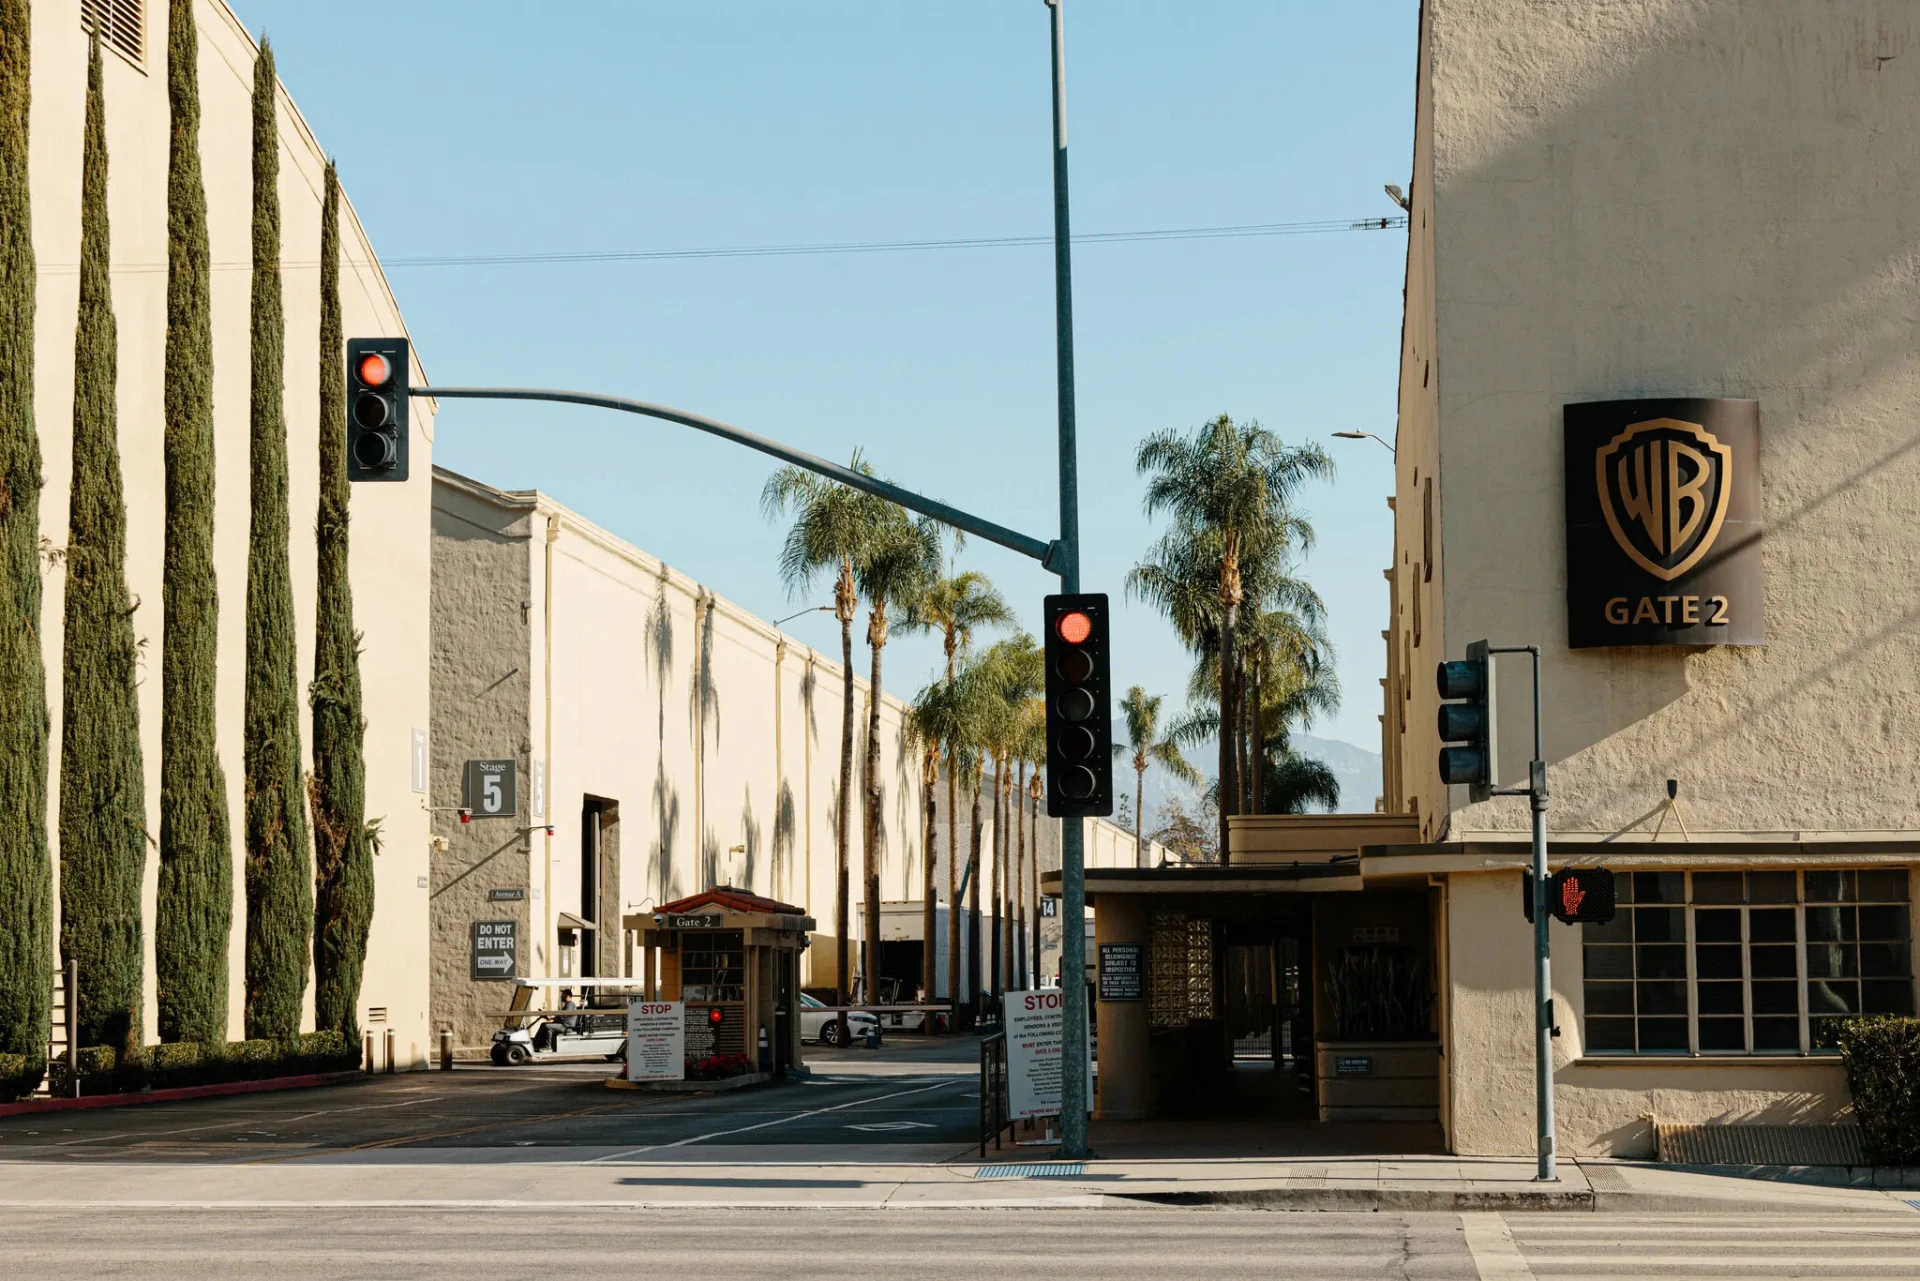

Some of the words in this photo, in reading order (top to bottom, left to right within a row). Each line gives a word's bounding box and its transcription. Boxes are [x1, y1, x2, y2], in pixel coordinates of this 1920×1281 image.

[1618, 440, 1710, 556] WB
[1604, 596, 1700, 625] GATE
[1711, 595, 1730, 624] 2
[480, 762, 506, 773] Stage
[484, 774, 502, 813] 5
[1042, 902, 1054, 916] 14
[676, 917, 700, 927] Gate
[704, 916, 711, 927] 2
[480, 925, 492, 934] DO
[495, 925, 512, 934] NOT
[478, 937, 514, 949] ENTER
[1024, 994, 1063, 1010] STO
[642, 1004, 672, 1014] STOP
